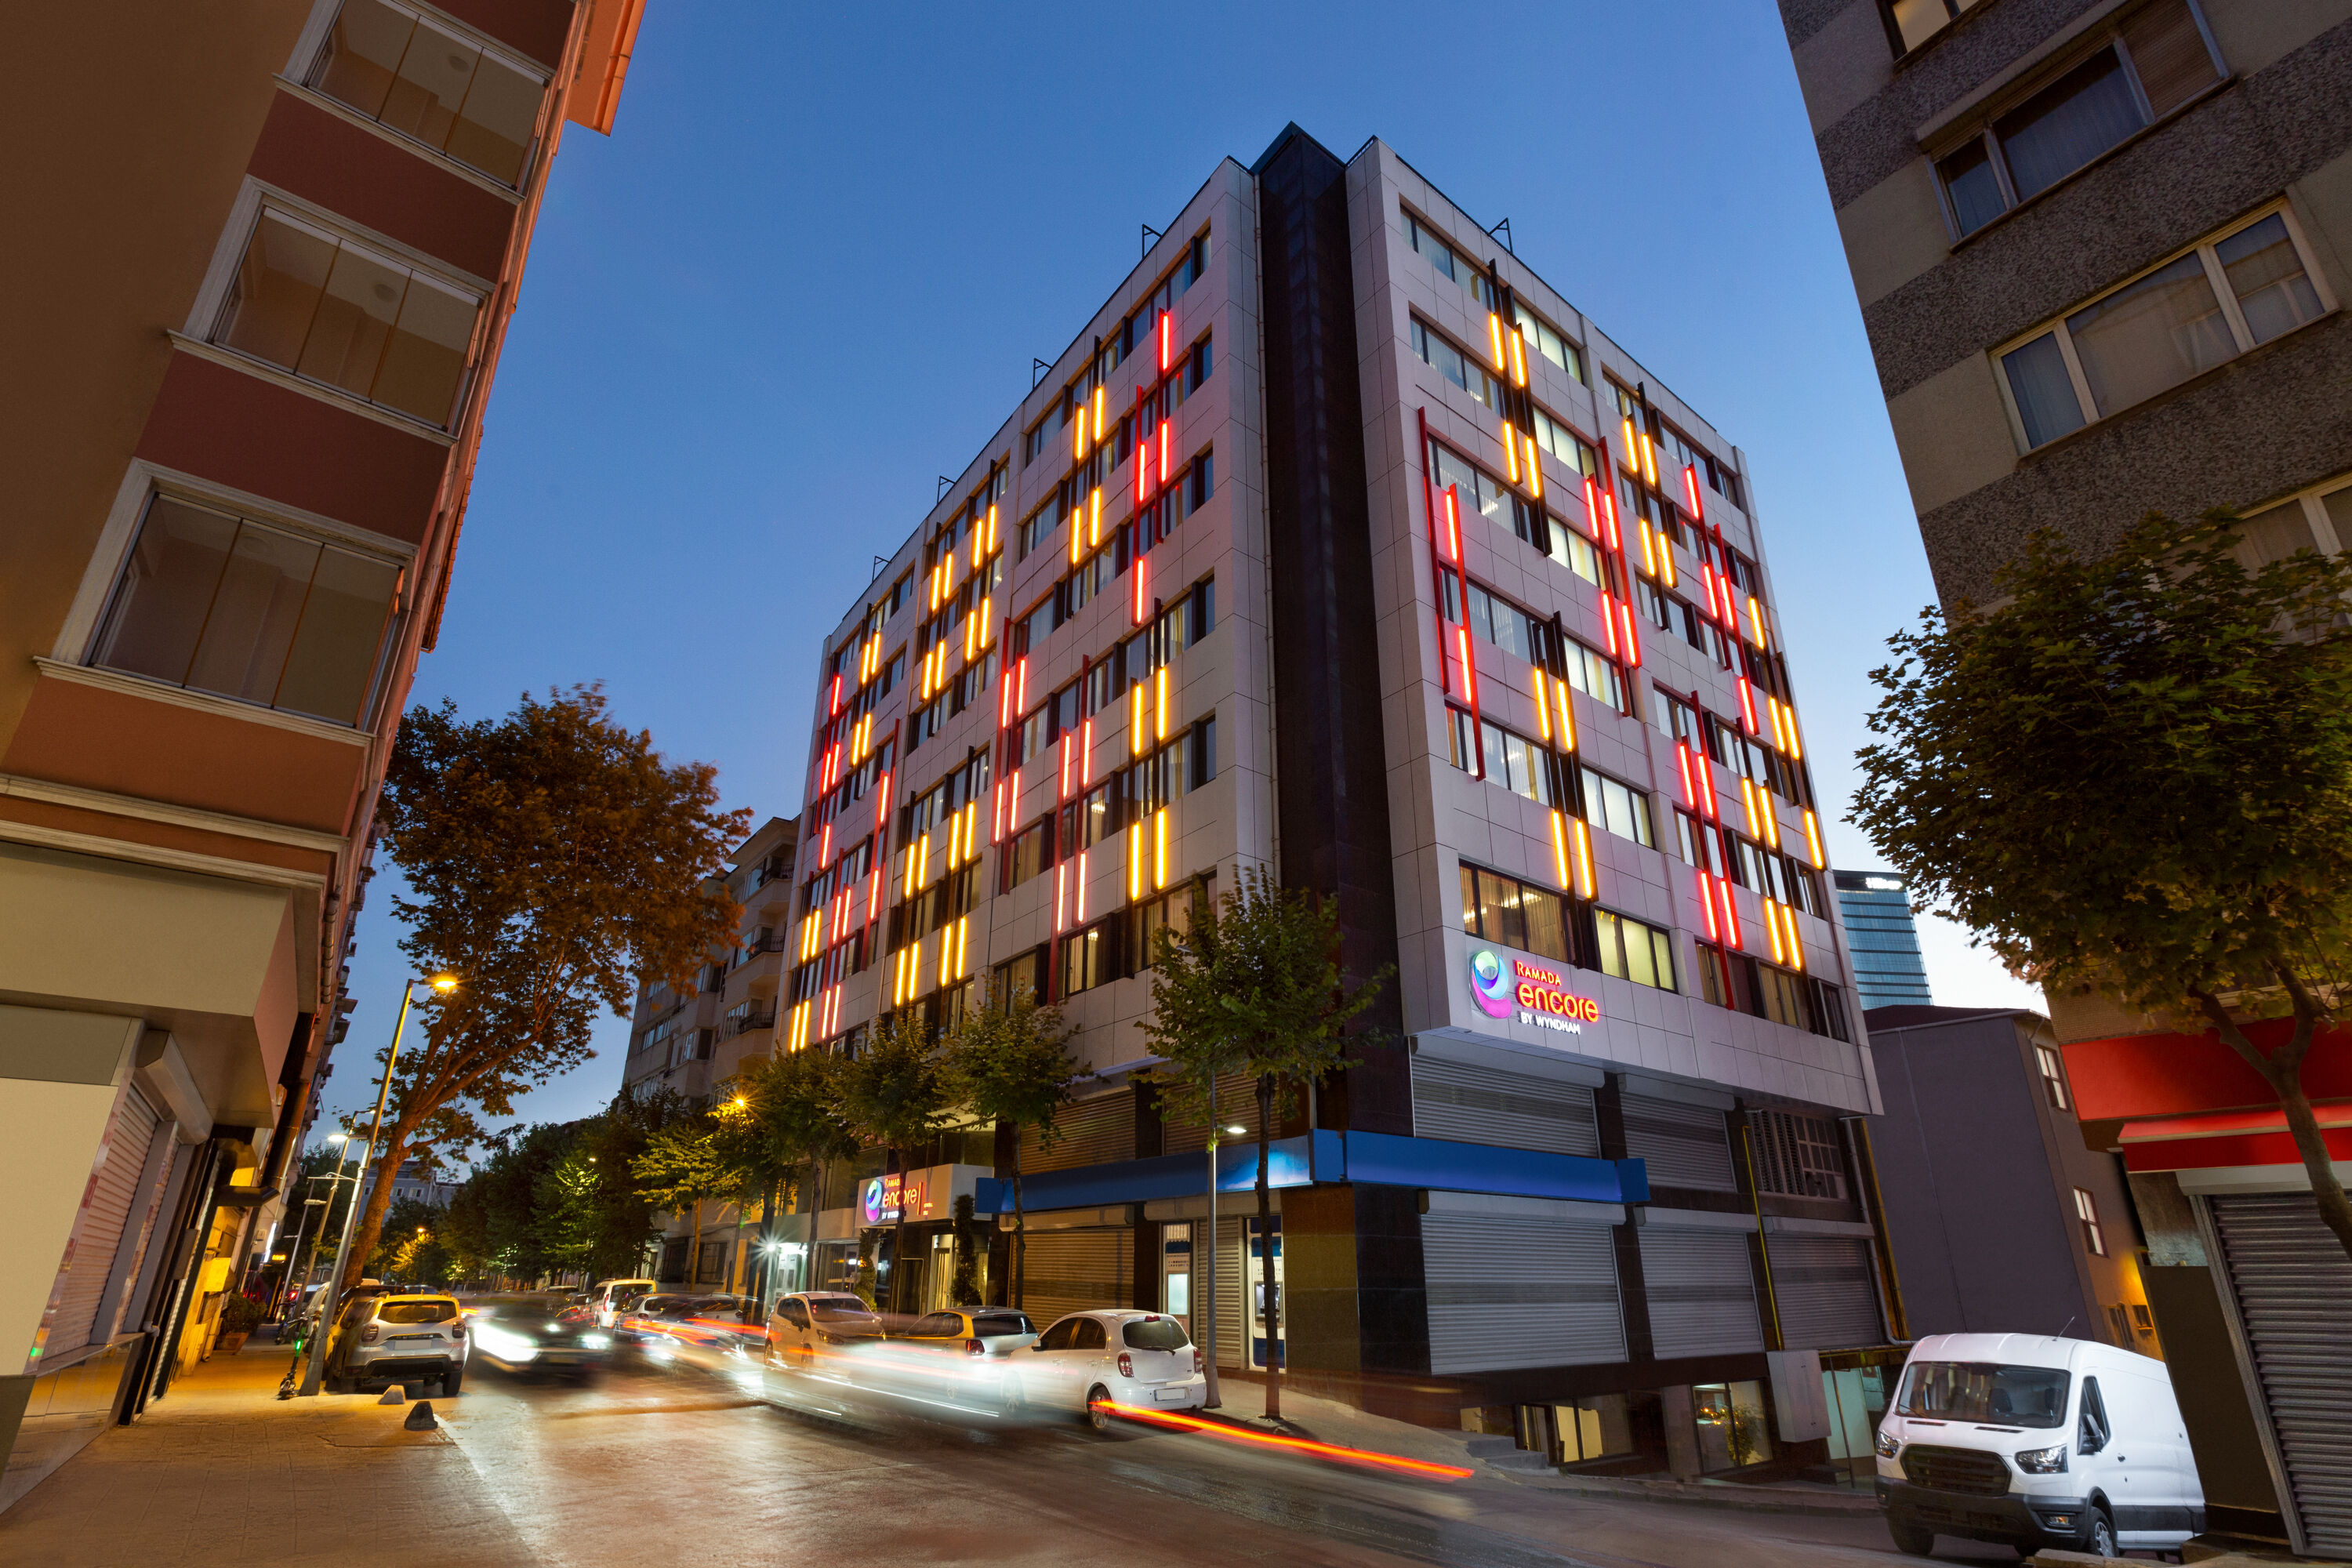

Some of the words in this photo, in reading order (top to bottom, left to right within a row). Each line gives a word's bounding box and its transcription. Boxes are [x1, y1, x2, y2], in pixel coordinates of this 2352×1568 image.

[1515, 961, 1562, 986] RAMADA
[1518, 983, 1599, 1023] encore
[1520, 1011, 1533, 1025] BY
[1535, 1014, 1581, 1035] WYNDHAM
[884, 1178, 900, 1189] RAMAD
